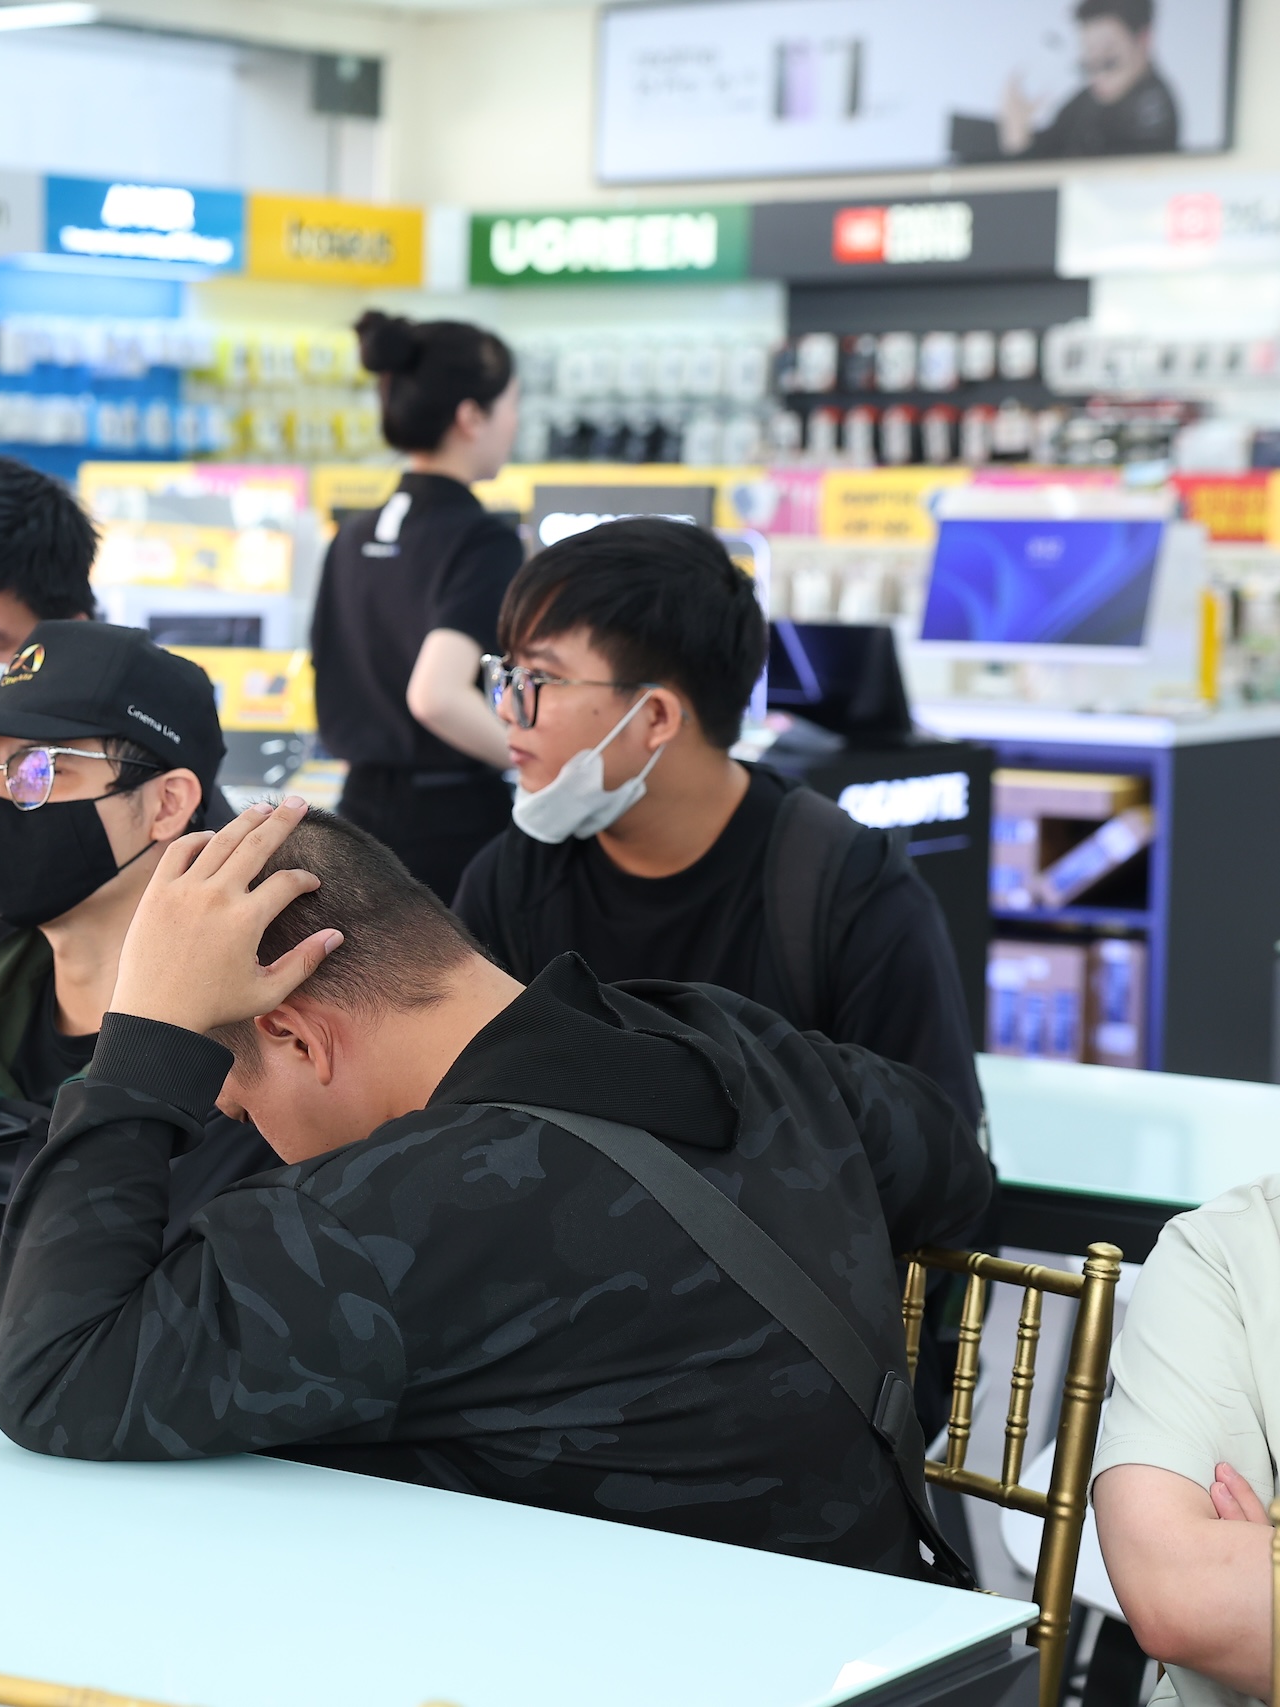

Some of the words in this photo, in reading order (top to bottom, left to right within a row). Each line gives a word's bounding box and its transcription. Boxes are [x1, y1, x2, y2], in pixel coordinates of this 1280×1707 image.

[491, 213, 718, 275] UGREEN
[127, 704, 162, 732] Cinema
[162, 725, 181, 745] Line
